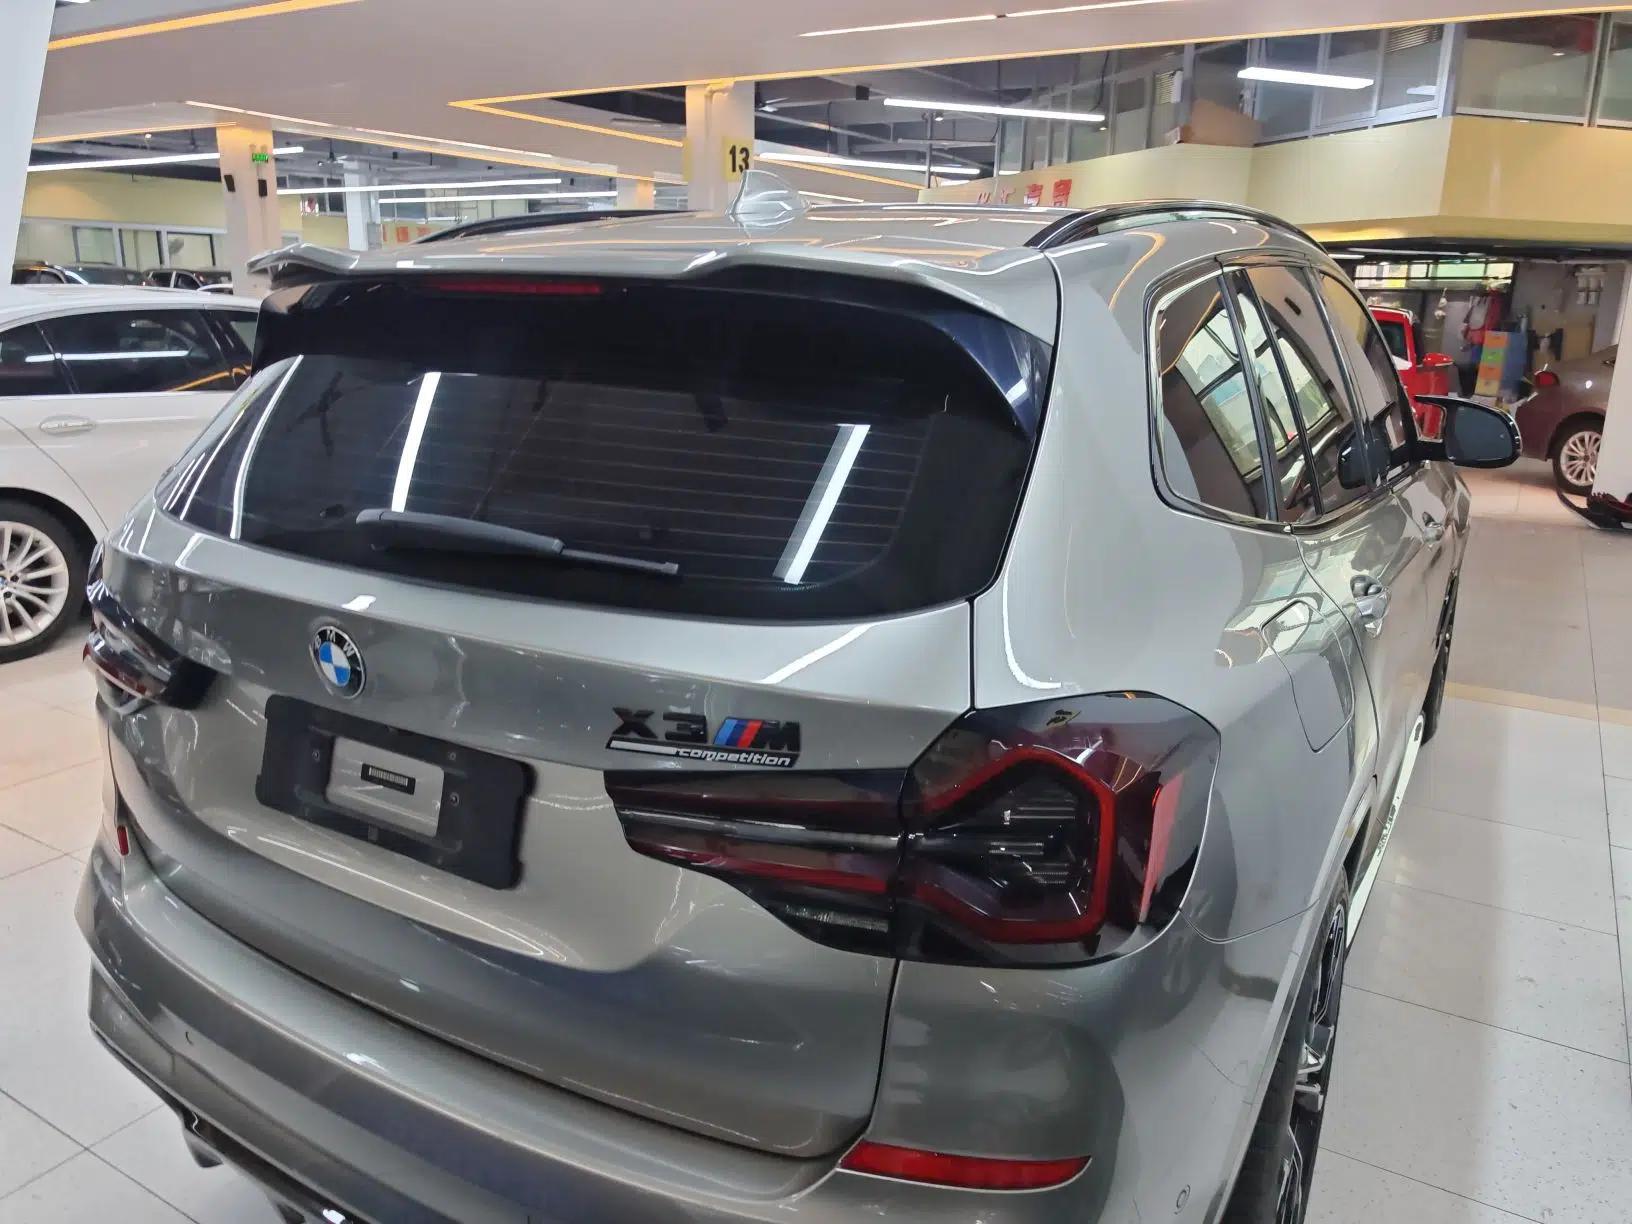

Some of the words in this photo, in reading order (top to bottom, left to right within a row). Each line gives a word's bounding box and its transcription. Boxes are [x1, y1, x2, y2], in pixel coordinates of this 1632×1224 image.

[729, 145, 750, 173] 13
[314, 628, 356, 657] BMW
[676, 748, 791, 767] competition
